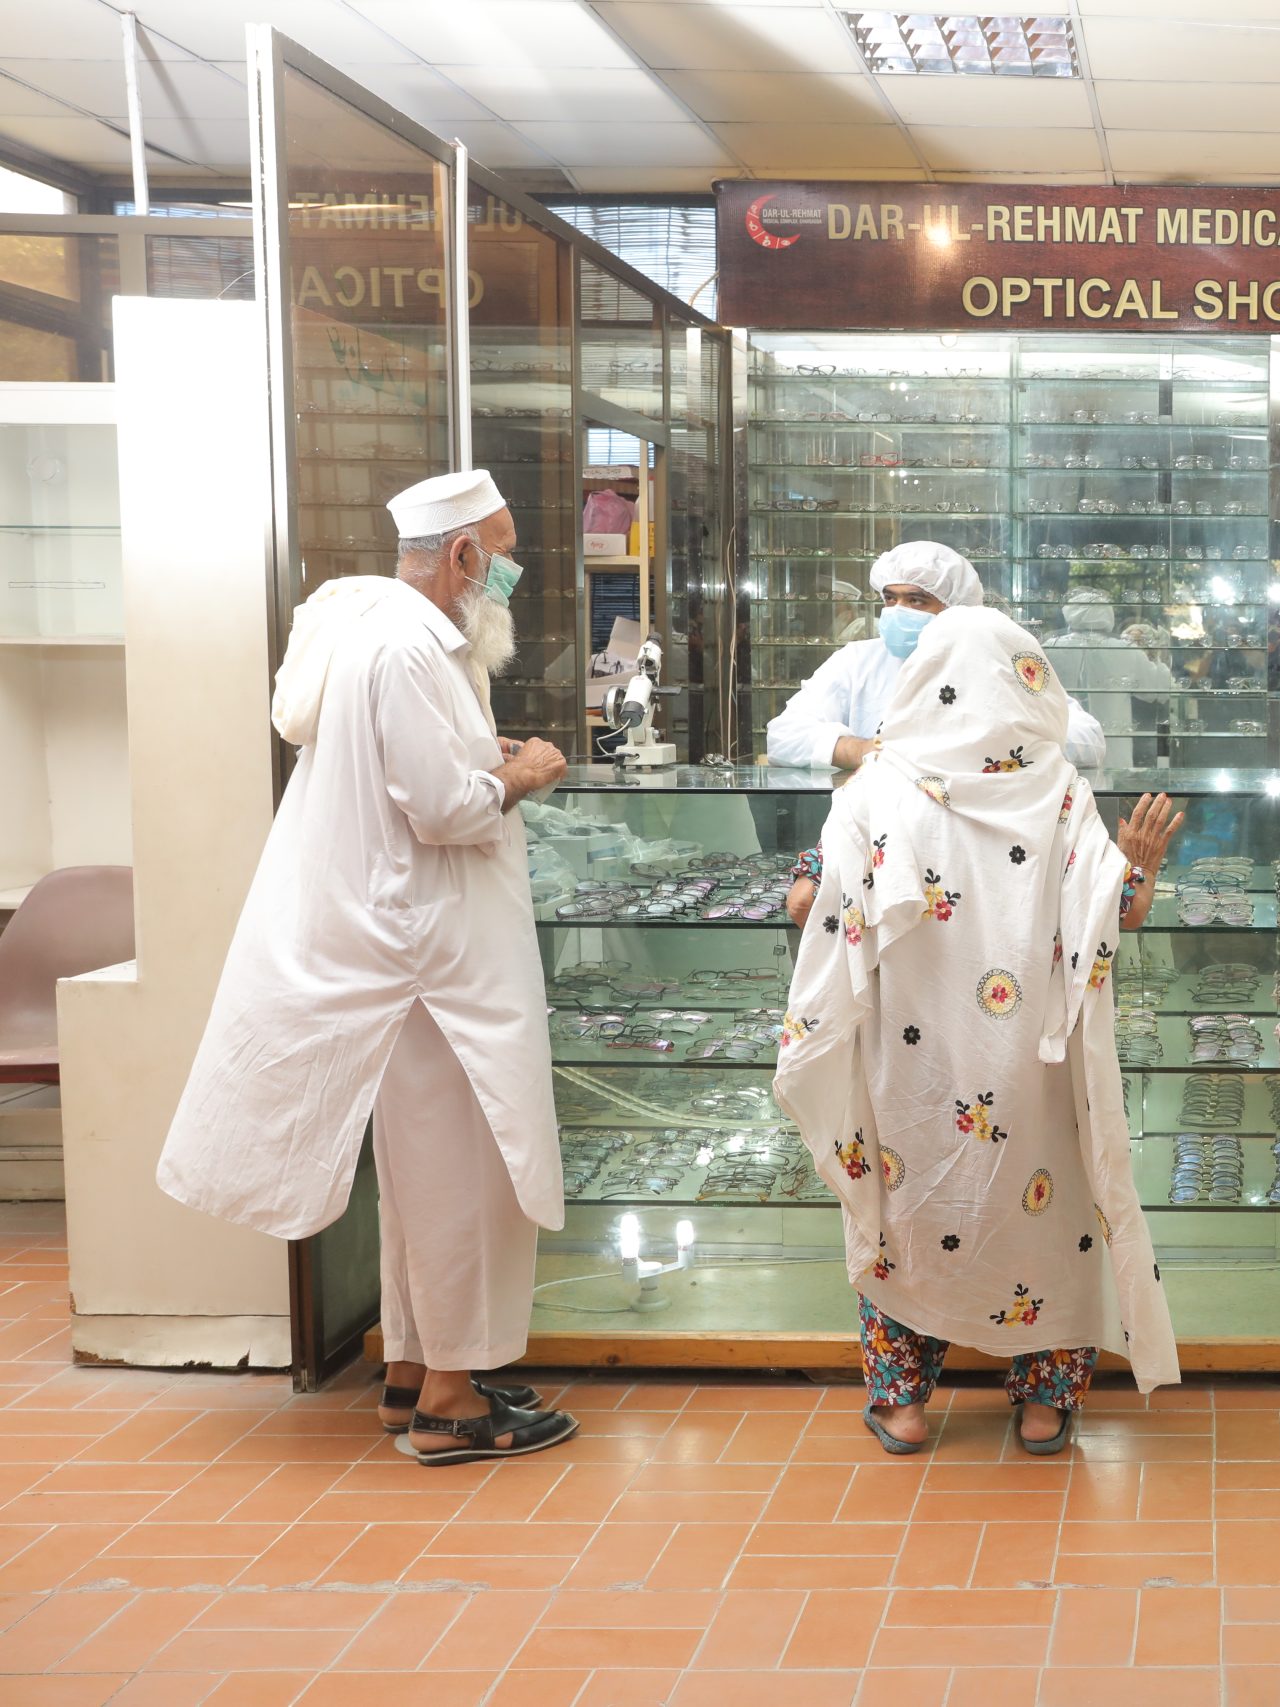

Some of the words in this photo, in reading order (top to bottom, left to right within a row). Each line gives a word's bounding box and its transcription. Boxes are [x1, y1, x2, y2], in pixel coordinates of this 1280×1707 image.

[762, 208, 822, 218] DAR-UL-REHMAT
[827, 203, 1144, 244] DAR-UL-REHMAT
[962, 276, 1179, 319] OPTICAL
